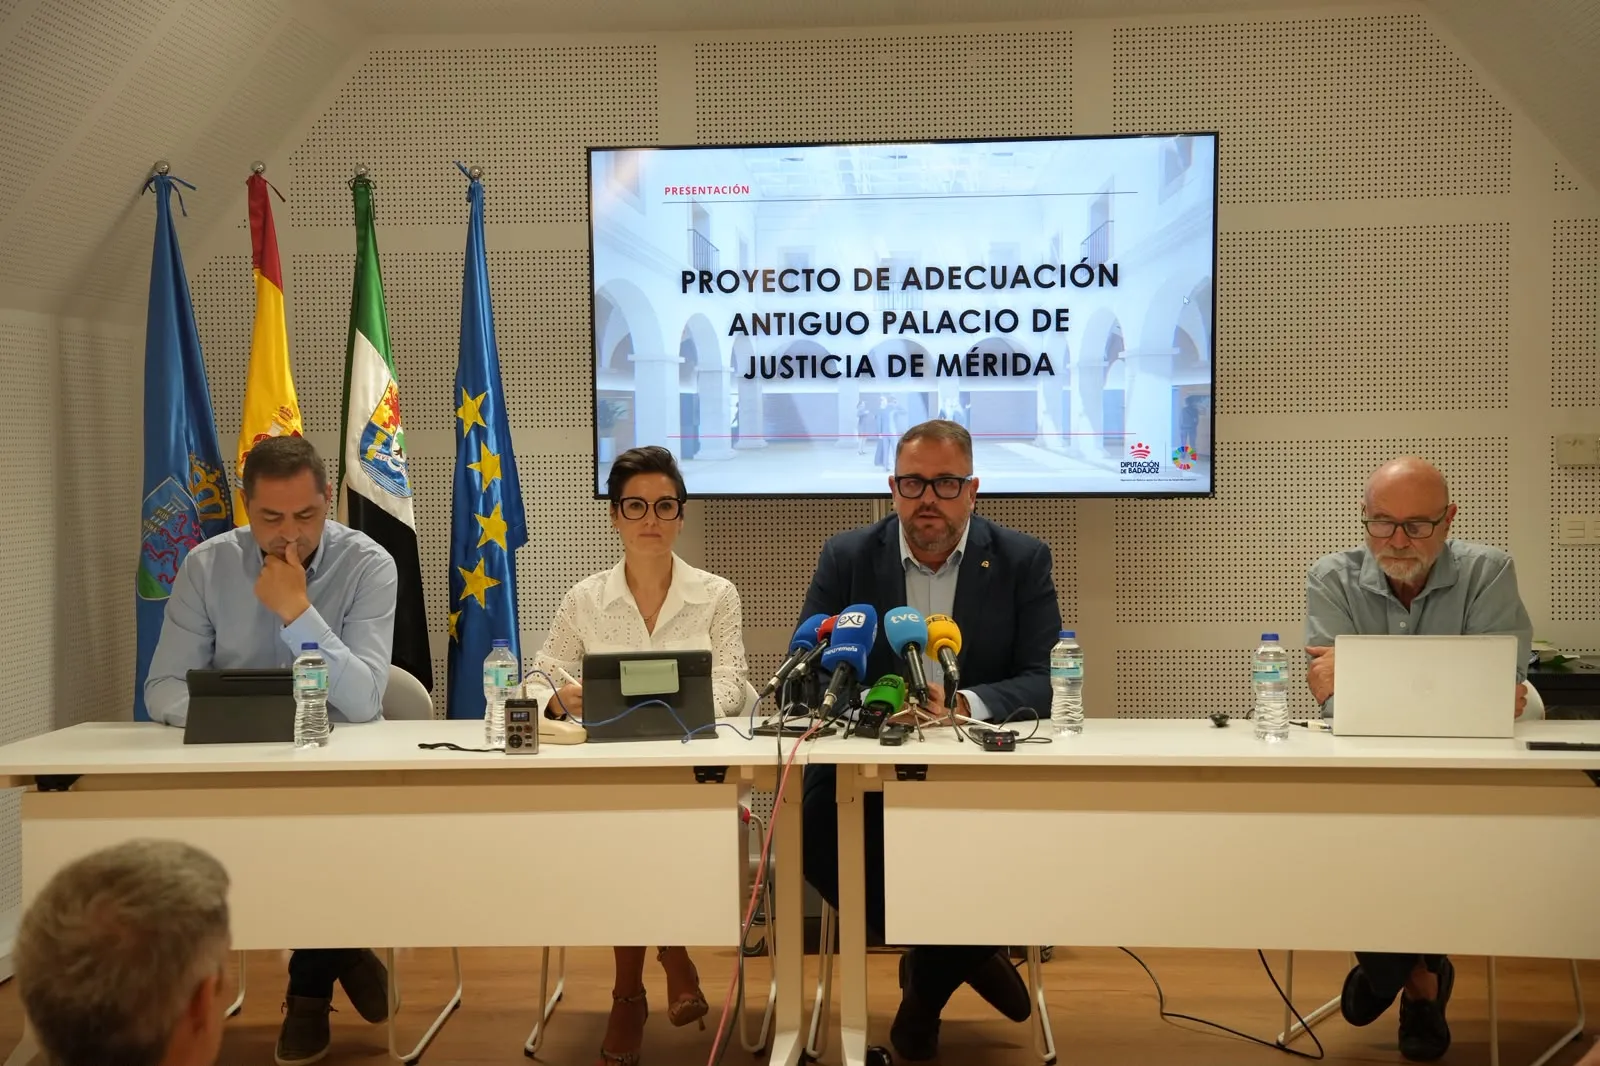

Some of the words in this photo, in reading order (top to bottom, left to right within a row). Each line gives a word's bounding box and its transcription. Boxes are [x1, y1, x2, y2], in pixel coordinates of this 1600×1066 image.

[664, 183, 750, 196] PRESENTACIÓN
[681, 267, 841, 294] PROYECTO
[853, 267, 890, 292] DE
[901, 256, 1119, 291] ADECUACIÓN
[727, 310, 870, 336] ANTIGUO
[882, 308, 1019, 335] PALACIO
[1032, 308, 1069, 333] DE
[743, 354, 876, 380] JUSTICIA
[887, 353, 924, 378] DE
[935, 346, 1056, 377] MÉRIDA
[1120, 460, 1160, 468] DIPUTACIÓN
[838, 614, 864, 627] ext
[890, 613, 920, 624] tve
